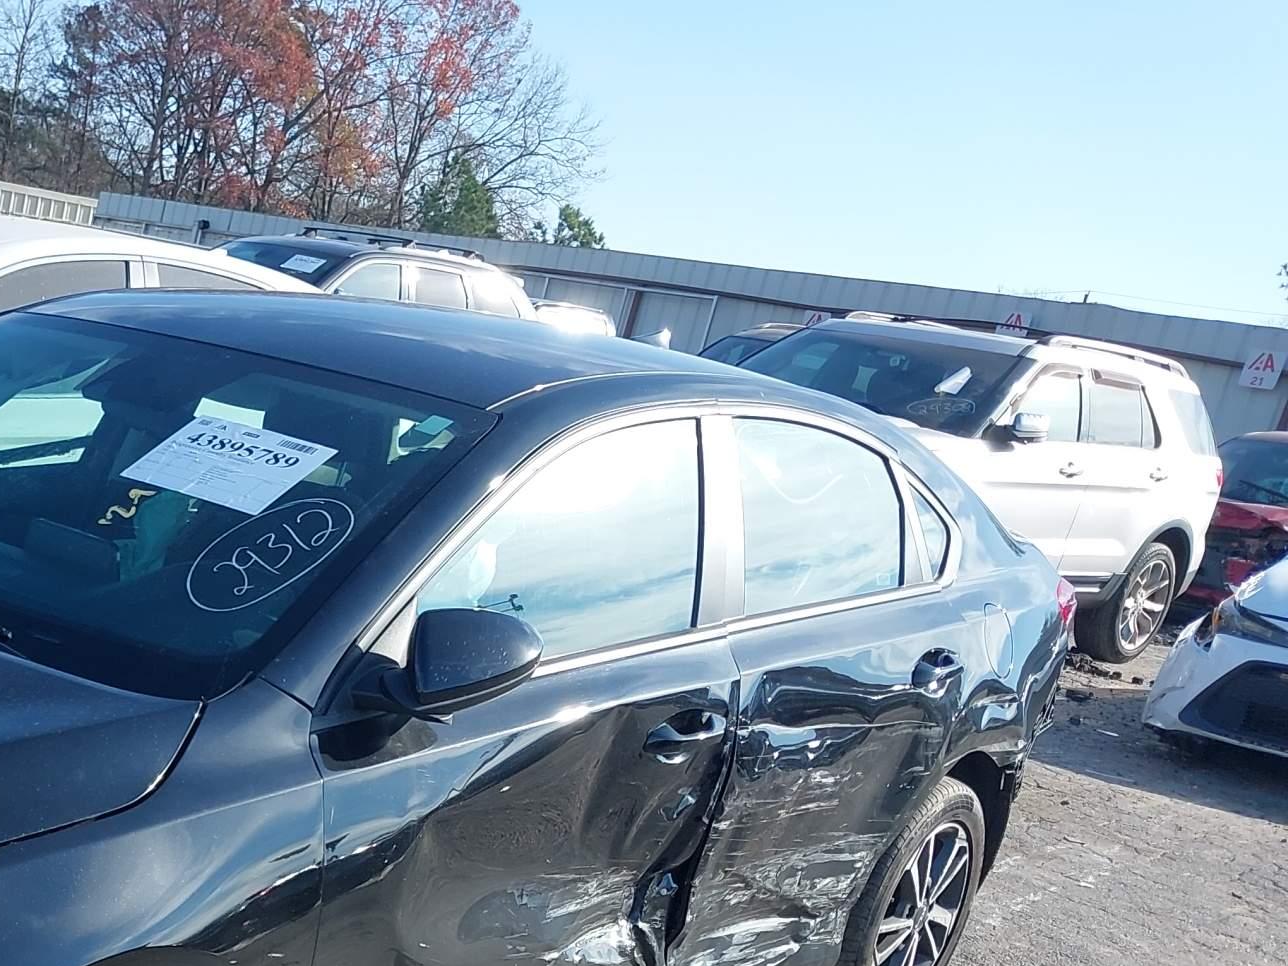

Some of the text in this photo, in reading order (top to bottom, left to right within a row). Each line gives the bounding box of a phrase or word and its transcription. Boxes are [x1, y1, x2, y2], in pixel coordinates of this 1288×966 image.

[1249, 376, 1264, 386] 21
[186, 432, 301, 468] 43895789
[213, 509, 340, 596] 29312
